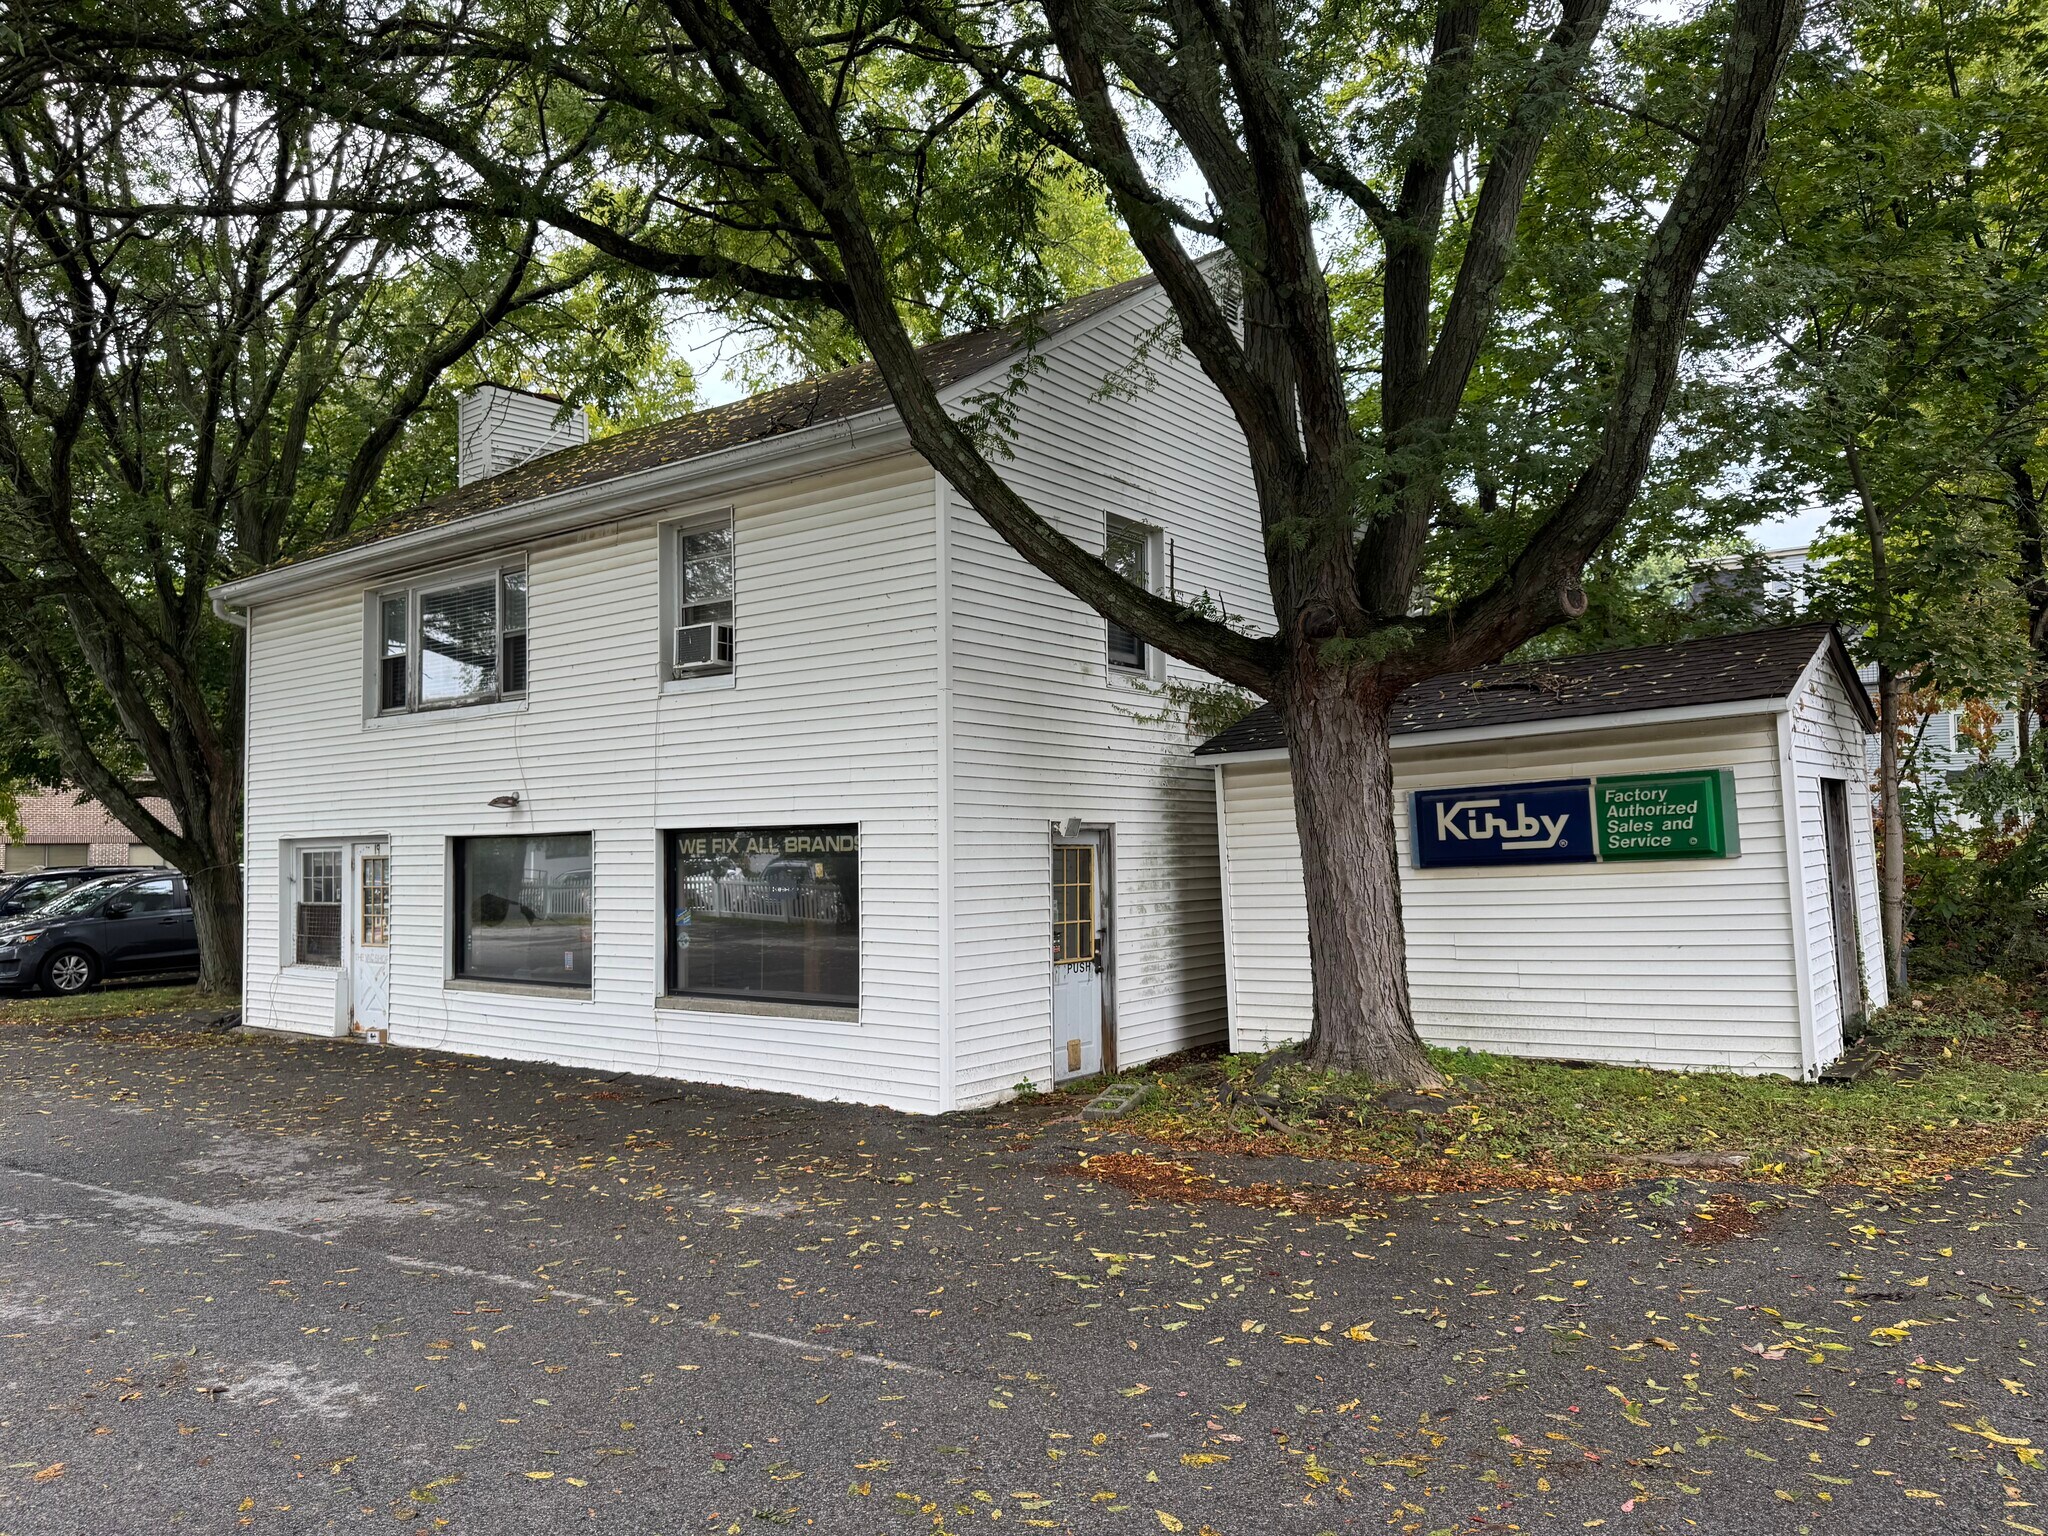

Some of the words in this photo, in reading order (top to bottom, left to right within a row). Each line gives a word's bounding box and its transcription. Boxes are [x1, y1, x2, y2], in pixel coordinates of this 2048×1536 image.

[1605, 788, 1667, 803] Factory
[1606, 800, 1698, 818] Authorized
[1436, 799, 1570, 850] Kirby
[1607, 819, 1654, 834] Sales
[1661, 816, 1694, 831] and
[678, 838, 707, 855] WE
[711, 837, 740, 854] FIX
[745, 836, 780, 854] ALL
[1608, 833, 1672, 849] Service
[1067, 962, 1091, 974] PUSH
